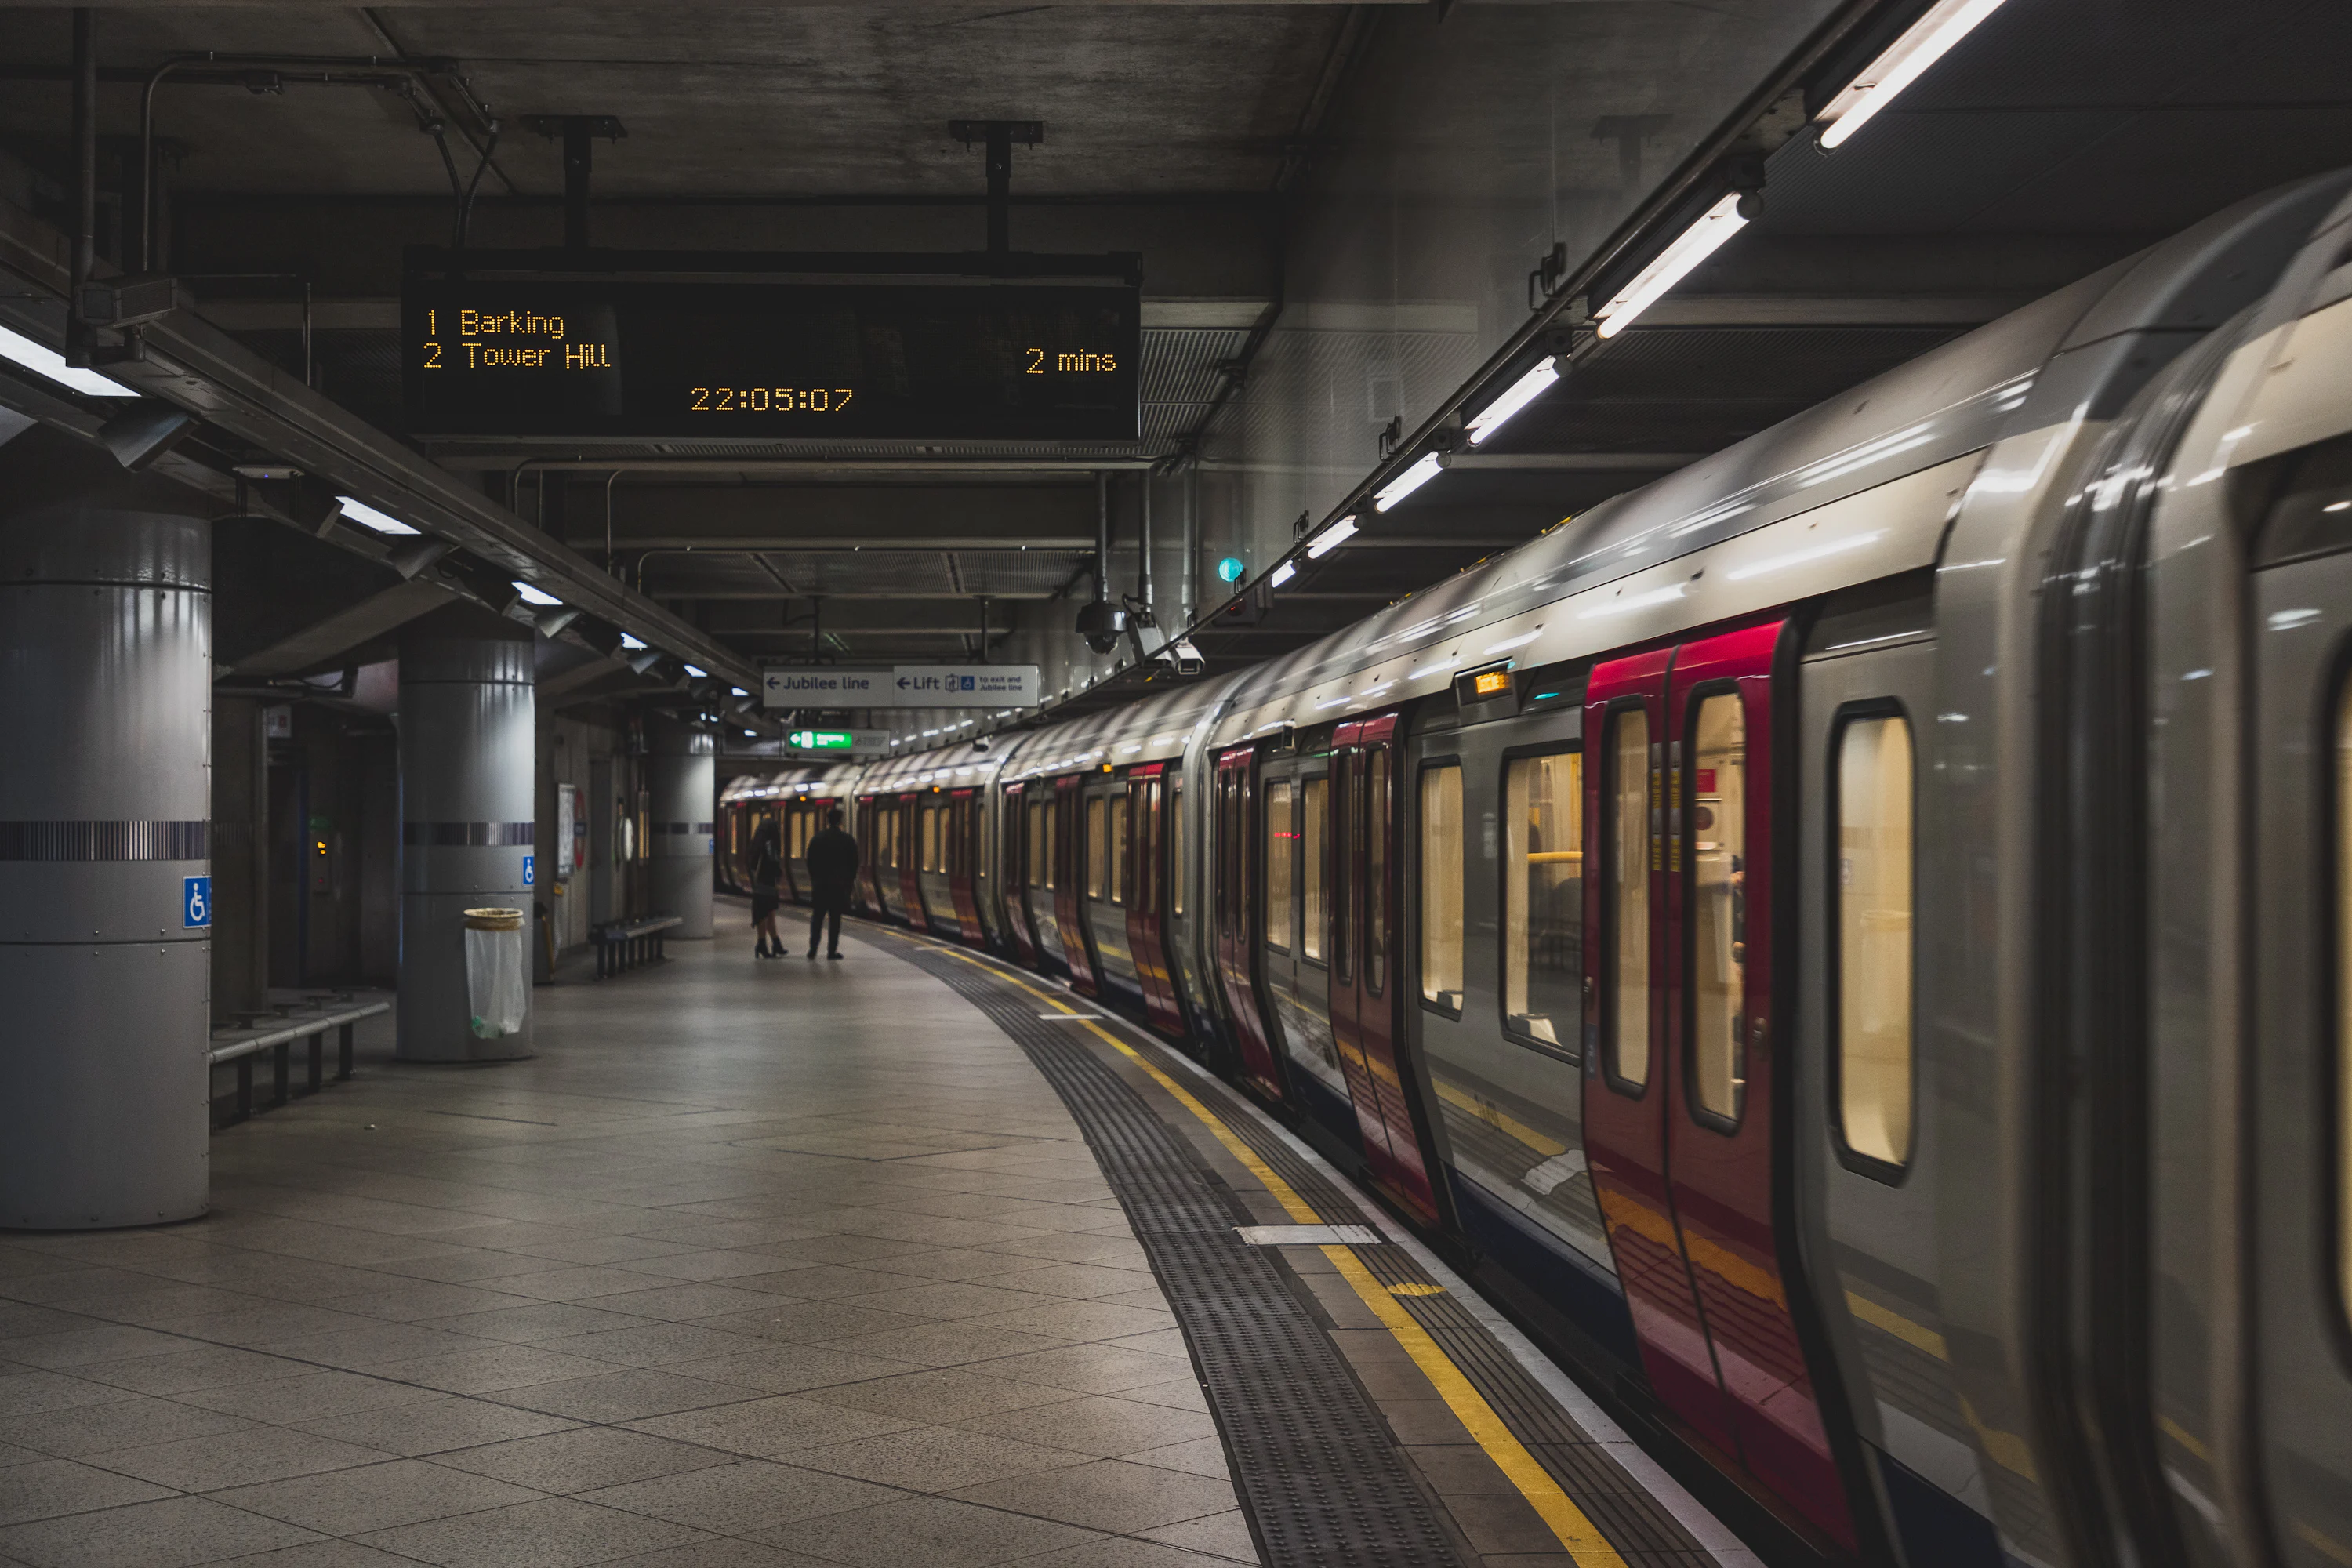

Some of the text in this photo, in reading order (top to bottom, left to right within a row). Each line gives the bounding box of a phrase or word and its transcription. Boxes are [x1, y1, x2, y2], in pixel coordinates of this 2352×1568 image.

[428, 310, 564, 339] 1 Barking
[423, 342, 1116, 374] 2 Tower Hill 2 mins
[691, 387, 852, 412] 22:05:07
[783, 676, 869, 690] Jubilee line
[913, 677, 940, 690] Lift
